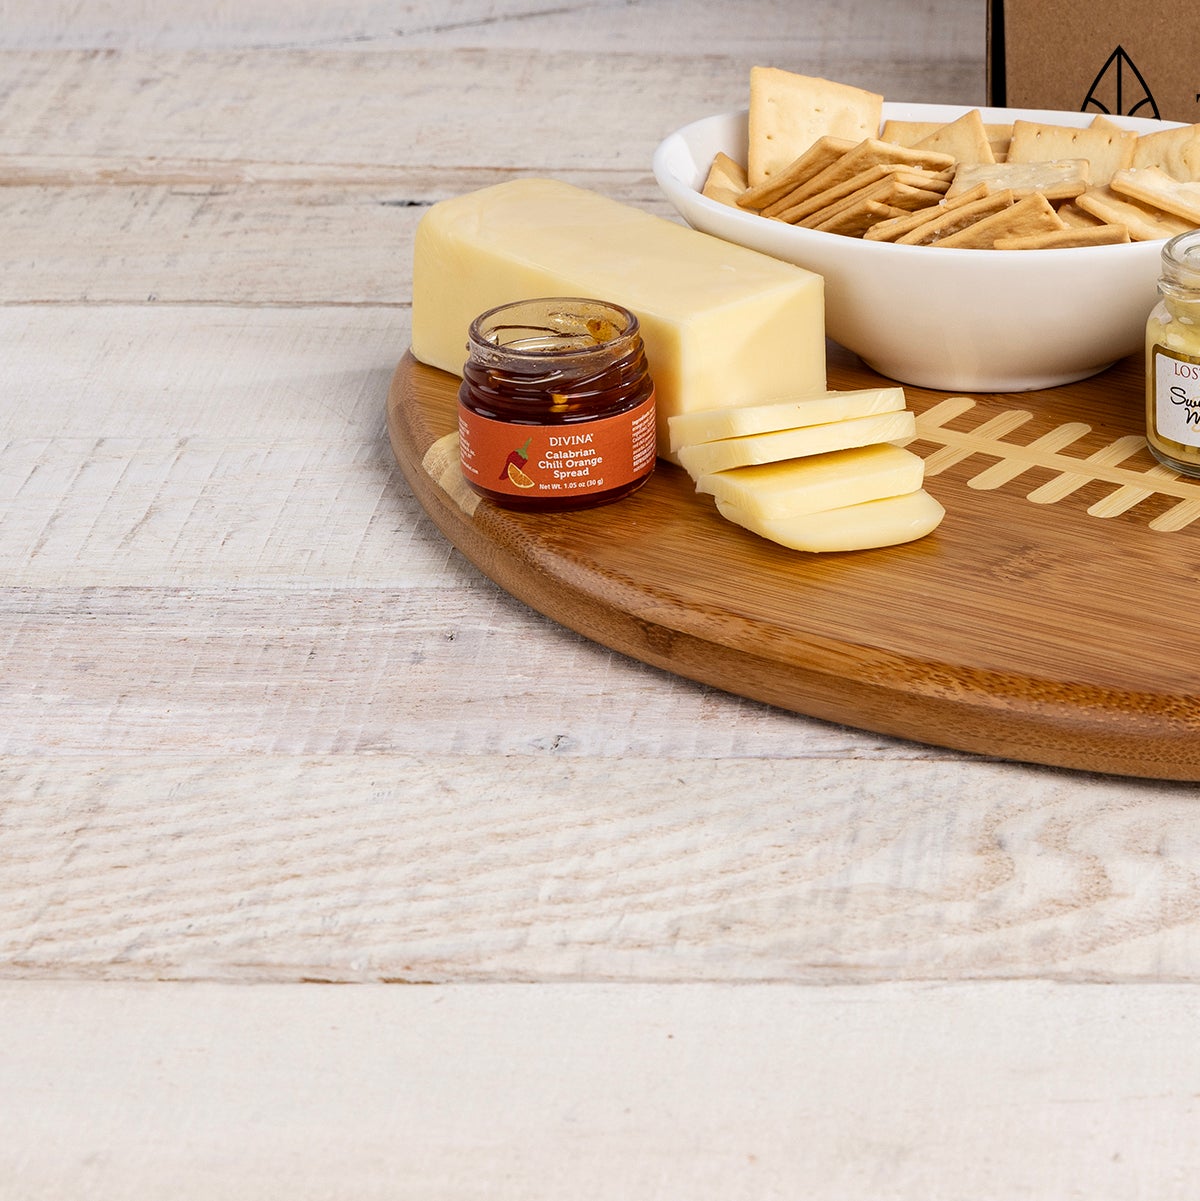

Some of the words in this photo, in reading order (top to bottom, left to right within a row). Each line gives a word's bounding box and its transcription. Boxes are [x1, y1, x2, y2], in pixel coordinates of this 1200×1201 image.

[549, 433, 593, 447] DIVINA
[545, 447, 596, 460] Calabrian
[538, 460, 563, 470] Chili
[565, 455, 603, 469] Orange
[553, 467, 590, 480] Spread
[539, 482, 550, 490] Net
